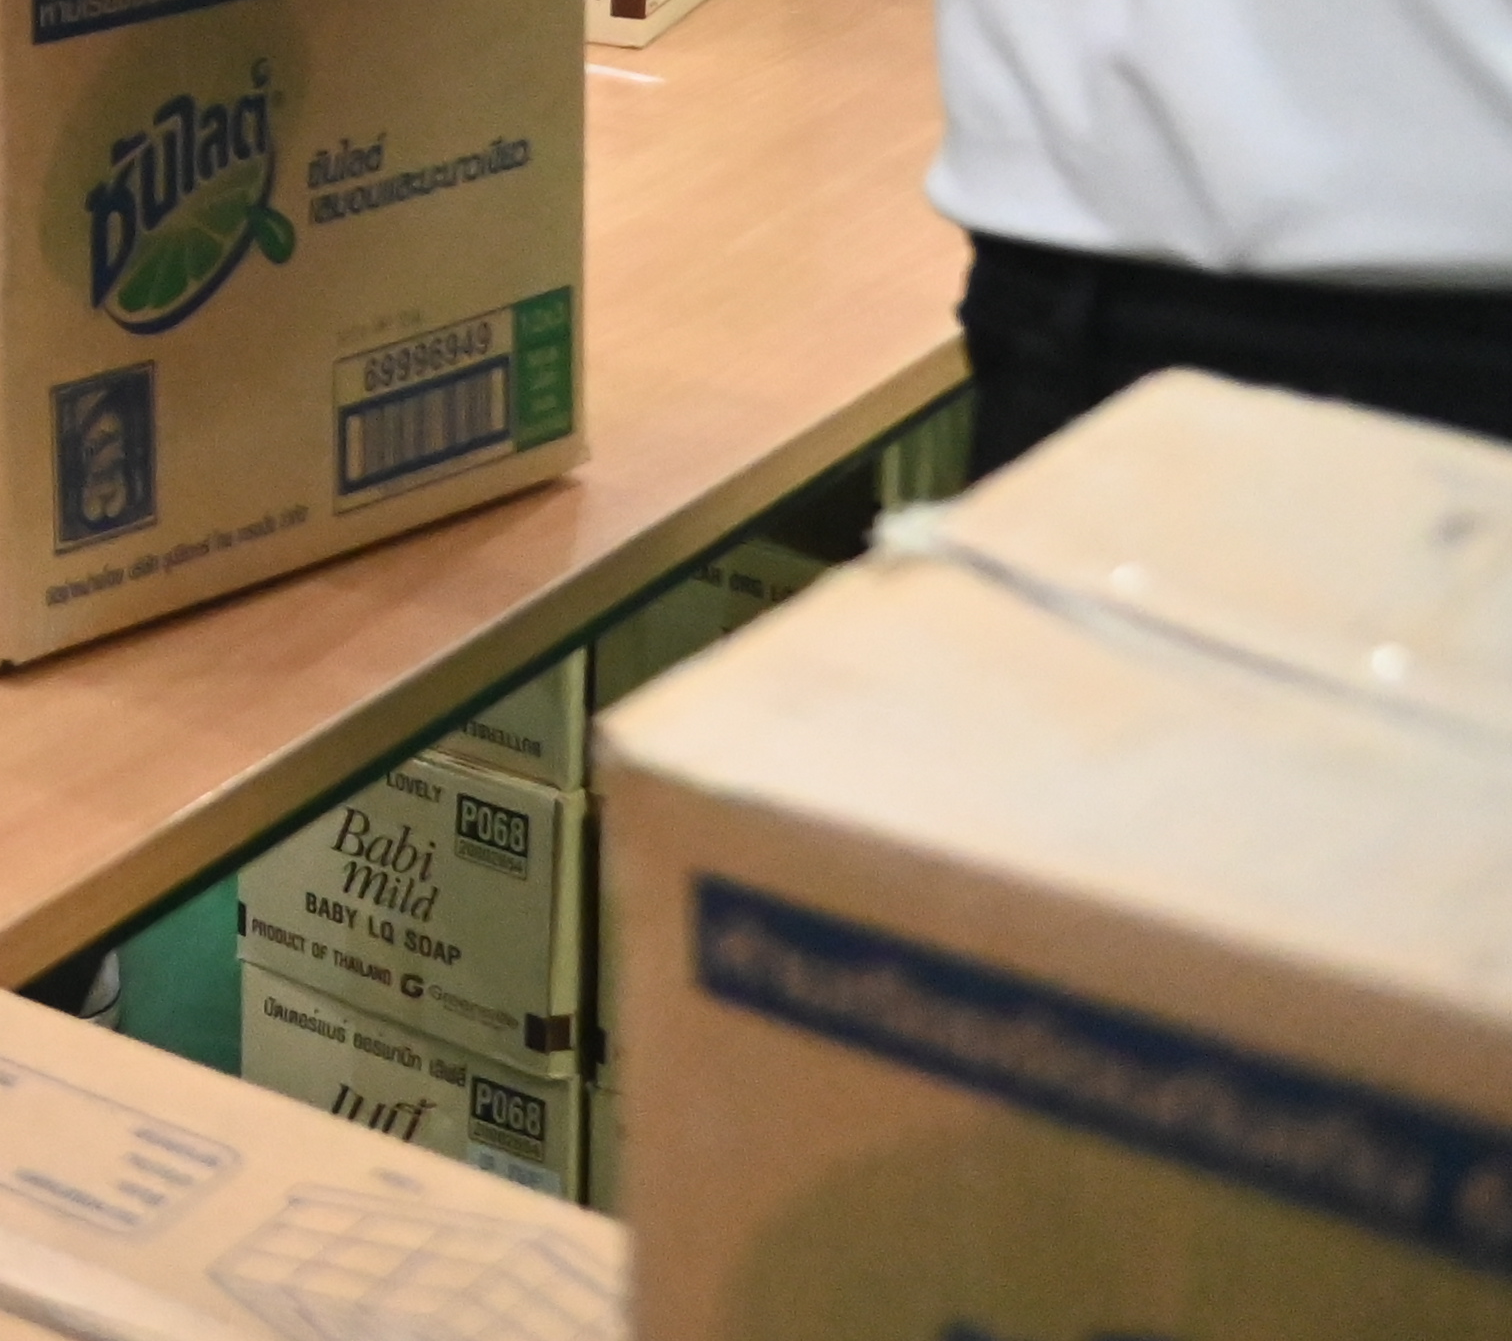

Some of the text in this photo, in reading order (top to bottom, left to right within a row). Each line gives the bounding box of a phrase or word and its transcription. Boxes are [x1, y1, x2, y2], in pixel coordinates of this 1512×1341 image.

[386, 771, 442, 803] LOVELY
[331, 806, 436, 883] Babi
[462, 799, 525, 853] P068
[252, 918, 306, 954] PRODUCT
[311, 941, 328, 960] OF
[305, 891, 462, 966] BABY LQ SOAP
[476, 1081, 542, 1137] P068
